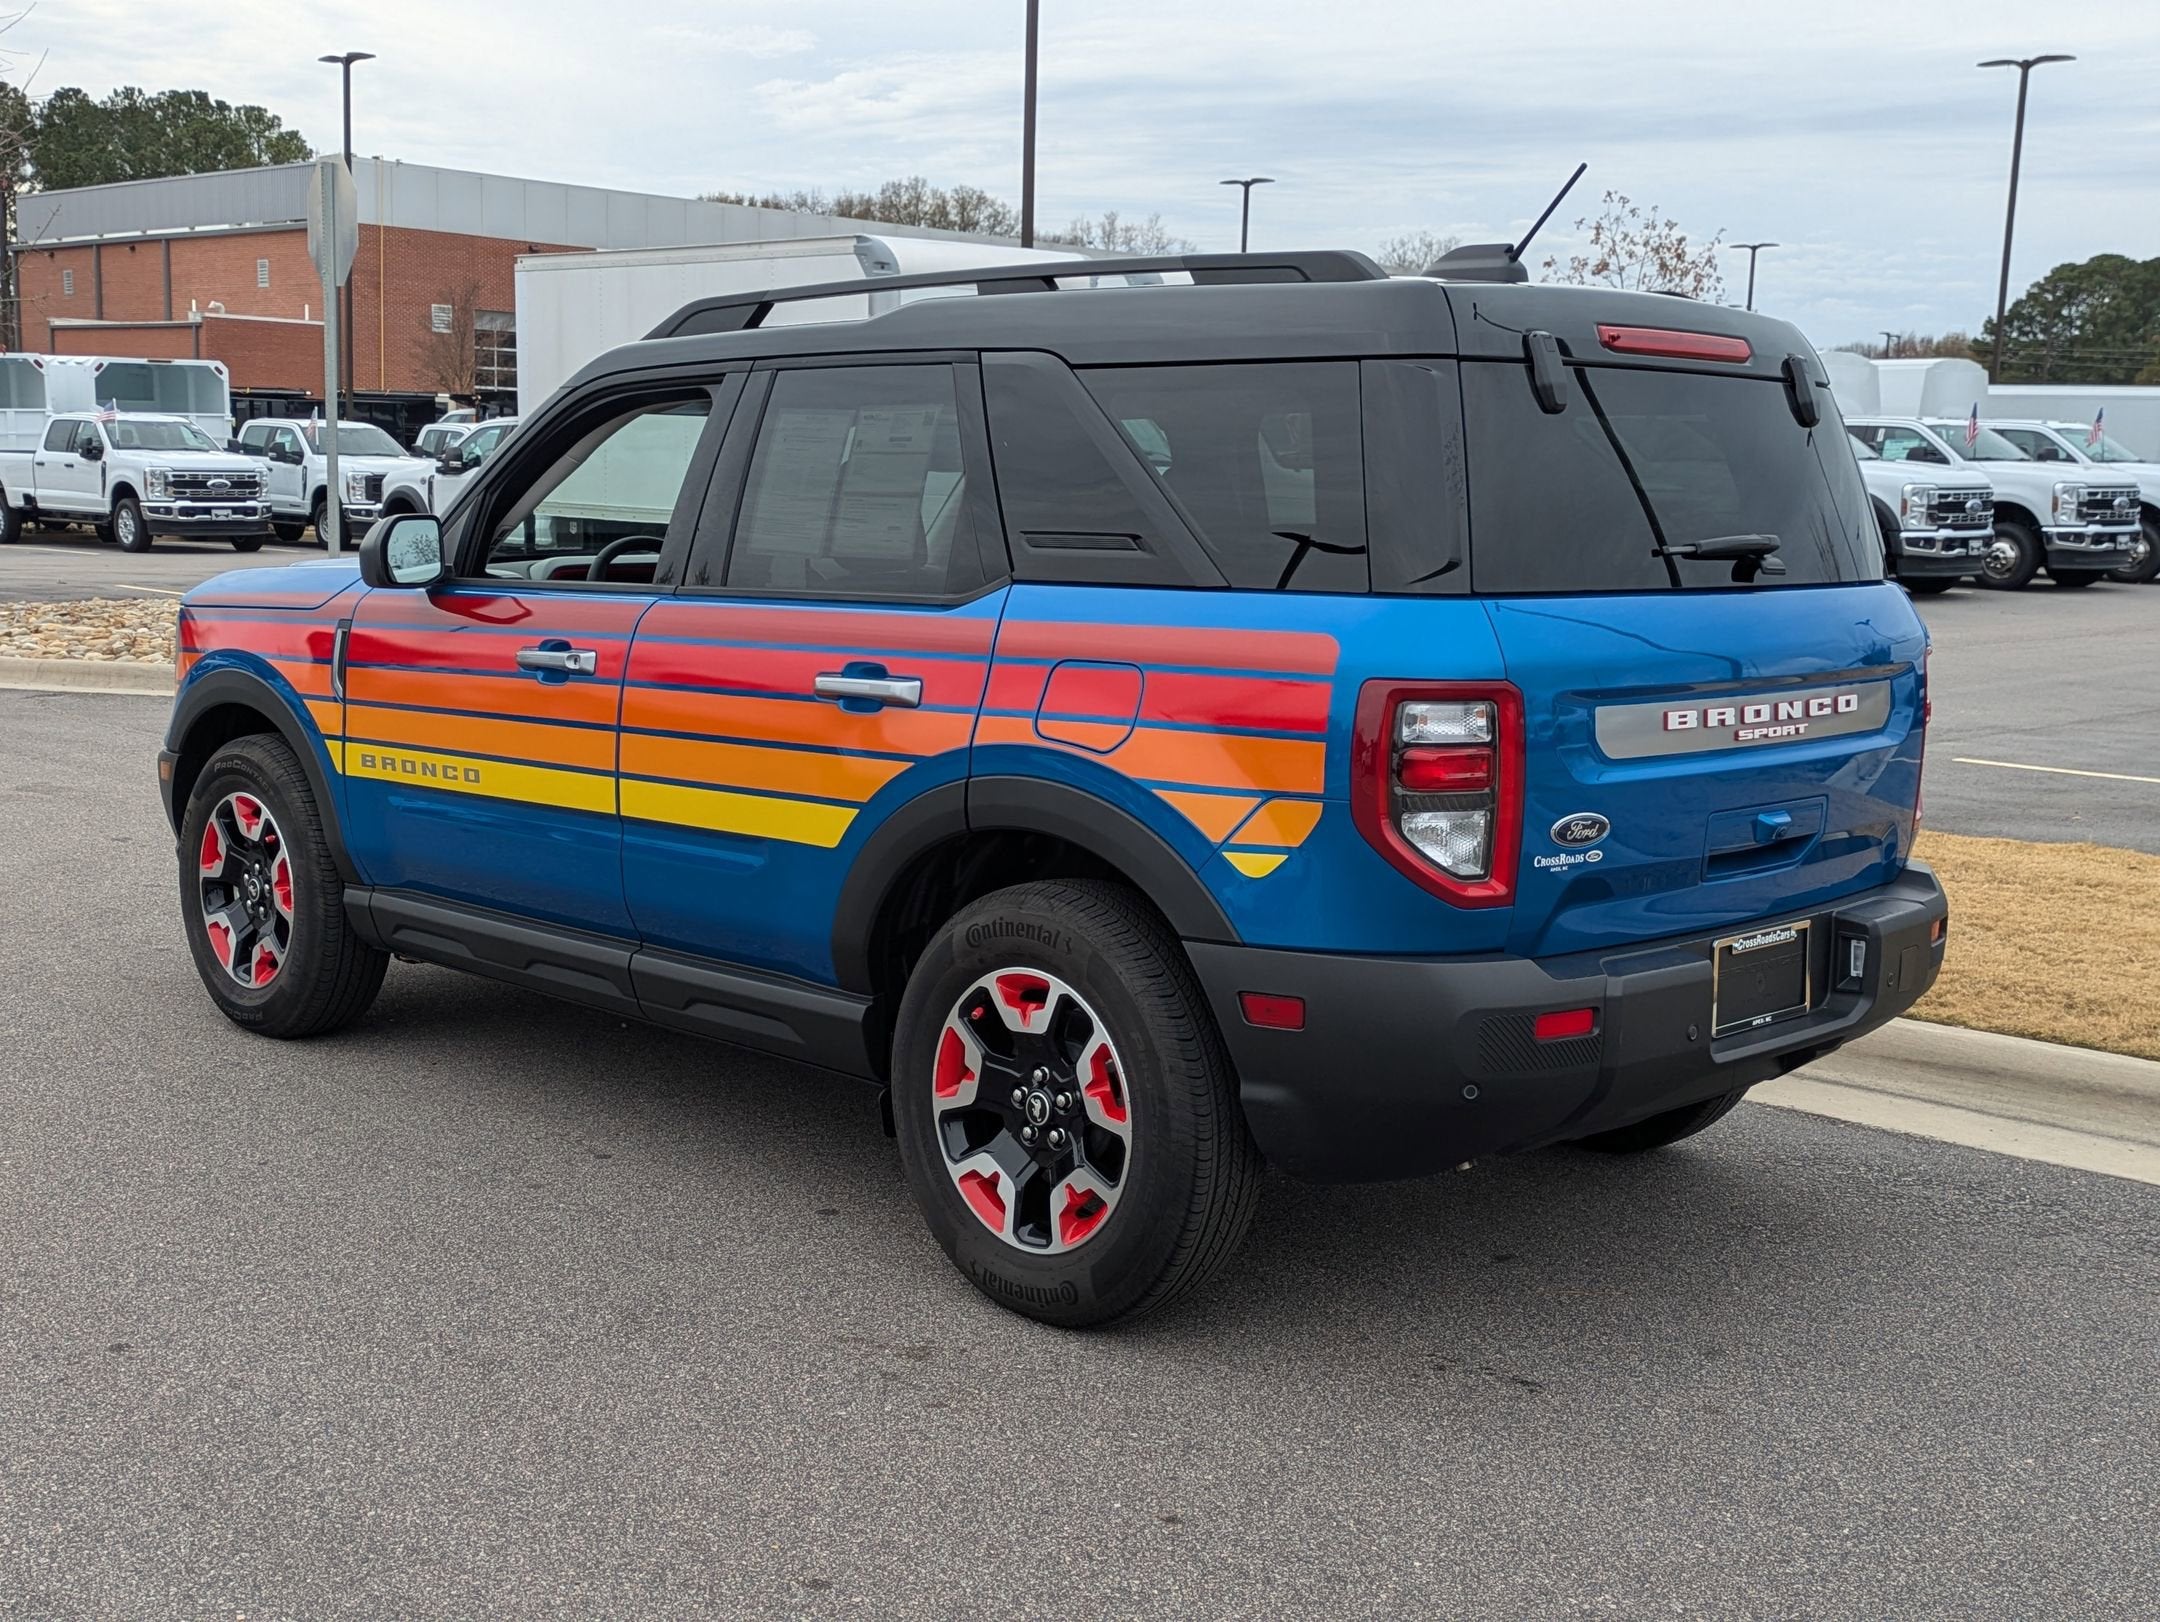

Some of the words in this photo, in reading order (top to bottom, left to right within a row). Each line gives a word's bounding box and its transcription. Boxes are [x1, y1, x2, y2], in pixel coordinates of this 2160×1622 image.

[1664, 694, 1859, 731] BRONCO
[1735, 723, 1809, 741] SPORT
[361, 754, 481, 784] BRONCO
[965, 916, 1062, 950] Continental
[981, 1267, 1079, 1309] Continental
